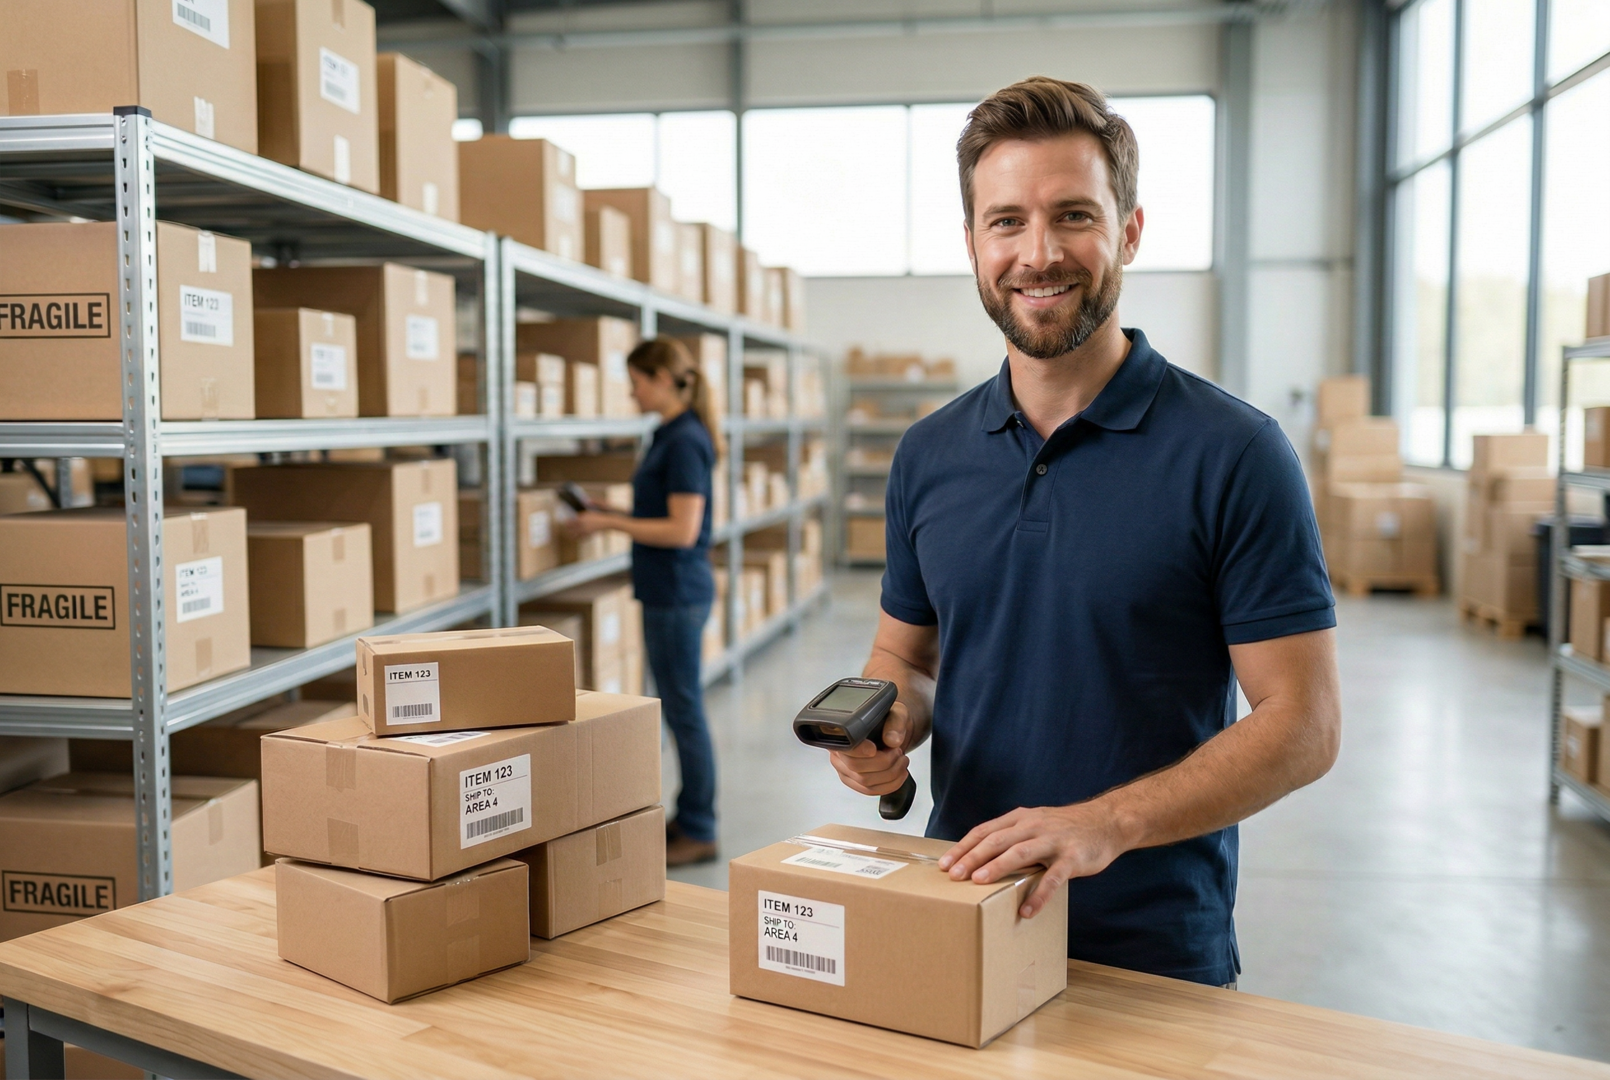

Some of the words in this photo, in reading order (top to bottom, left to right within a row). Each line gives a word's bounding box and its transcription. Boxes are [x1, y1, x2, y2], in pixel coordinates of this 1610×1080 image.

[184, 293, 204, 308] ITEM
[0, 302, 103, 330] FRAGILE
[7, 593, 108, 620] FRAGILE
[389, 671, 413, 680] ITEM
[415, 669, 431, 678] 123
[465, 770, 492, 788] ITEM
[494, 765, 513, 780] 123
[465, 791, 482, 802] SHIP
[482, 788, 495, 797] TO:
[465, 799, 491, 816] AREA
[492, 797, 498, 807] 4
[9, 880, 109, 909] FRAGILE
[764, 898, 791, 914] ITEM
[794, 904, 813, 918] 123
[764, 915, 782, 927] SHIP
[783, 919, 797, 930] TO:
[764, 926, 791, 942] AREA
[792, 932, 798, 943] 4
